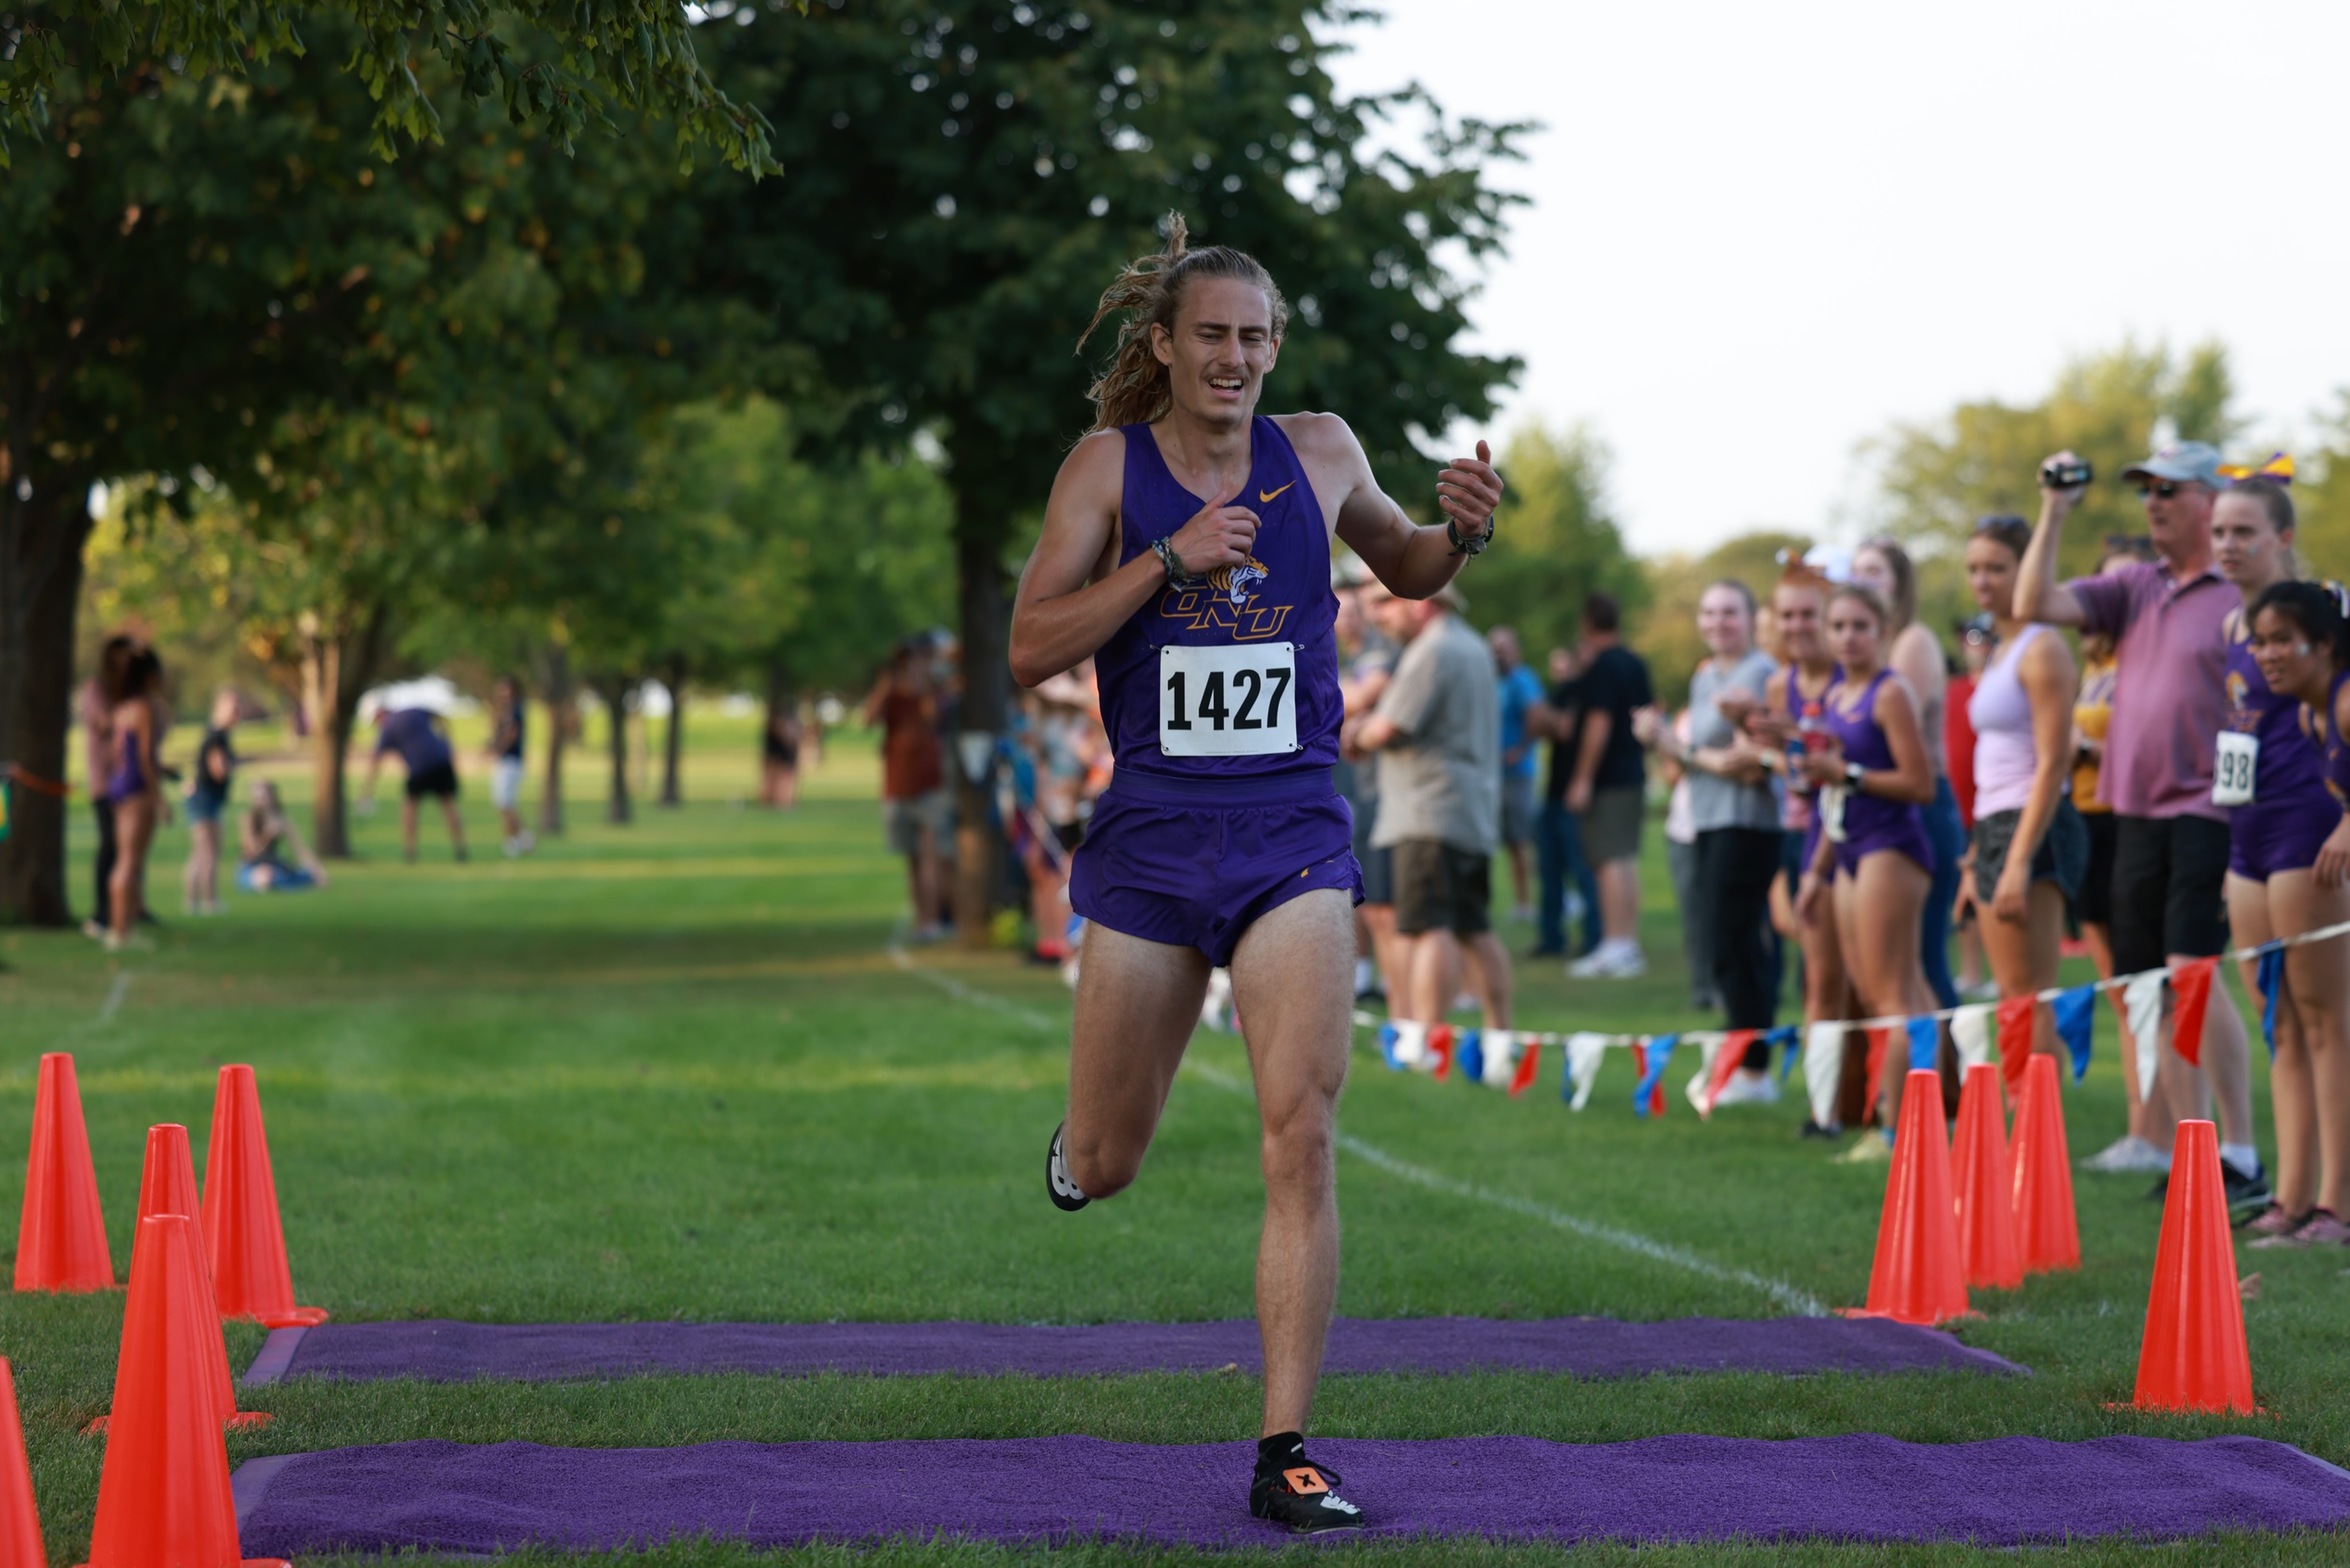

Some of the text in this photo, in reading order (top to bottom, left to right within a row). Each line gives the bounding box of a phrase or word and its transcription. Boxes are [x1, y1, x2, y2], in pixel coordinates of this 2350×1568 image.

[1160, 585, 1295, 641] ONU
[1167, 667, 1291, 731] 1427
[2214, 751, 2250, 791] 98
